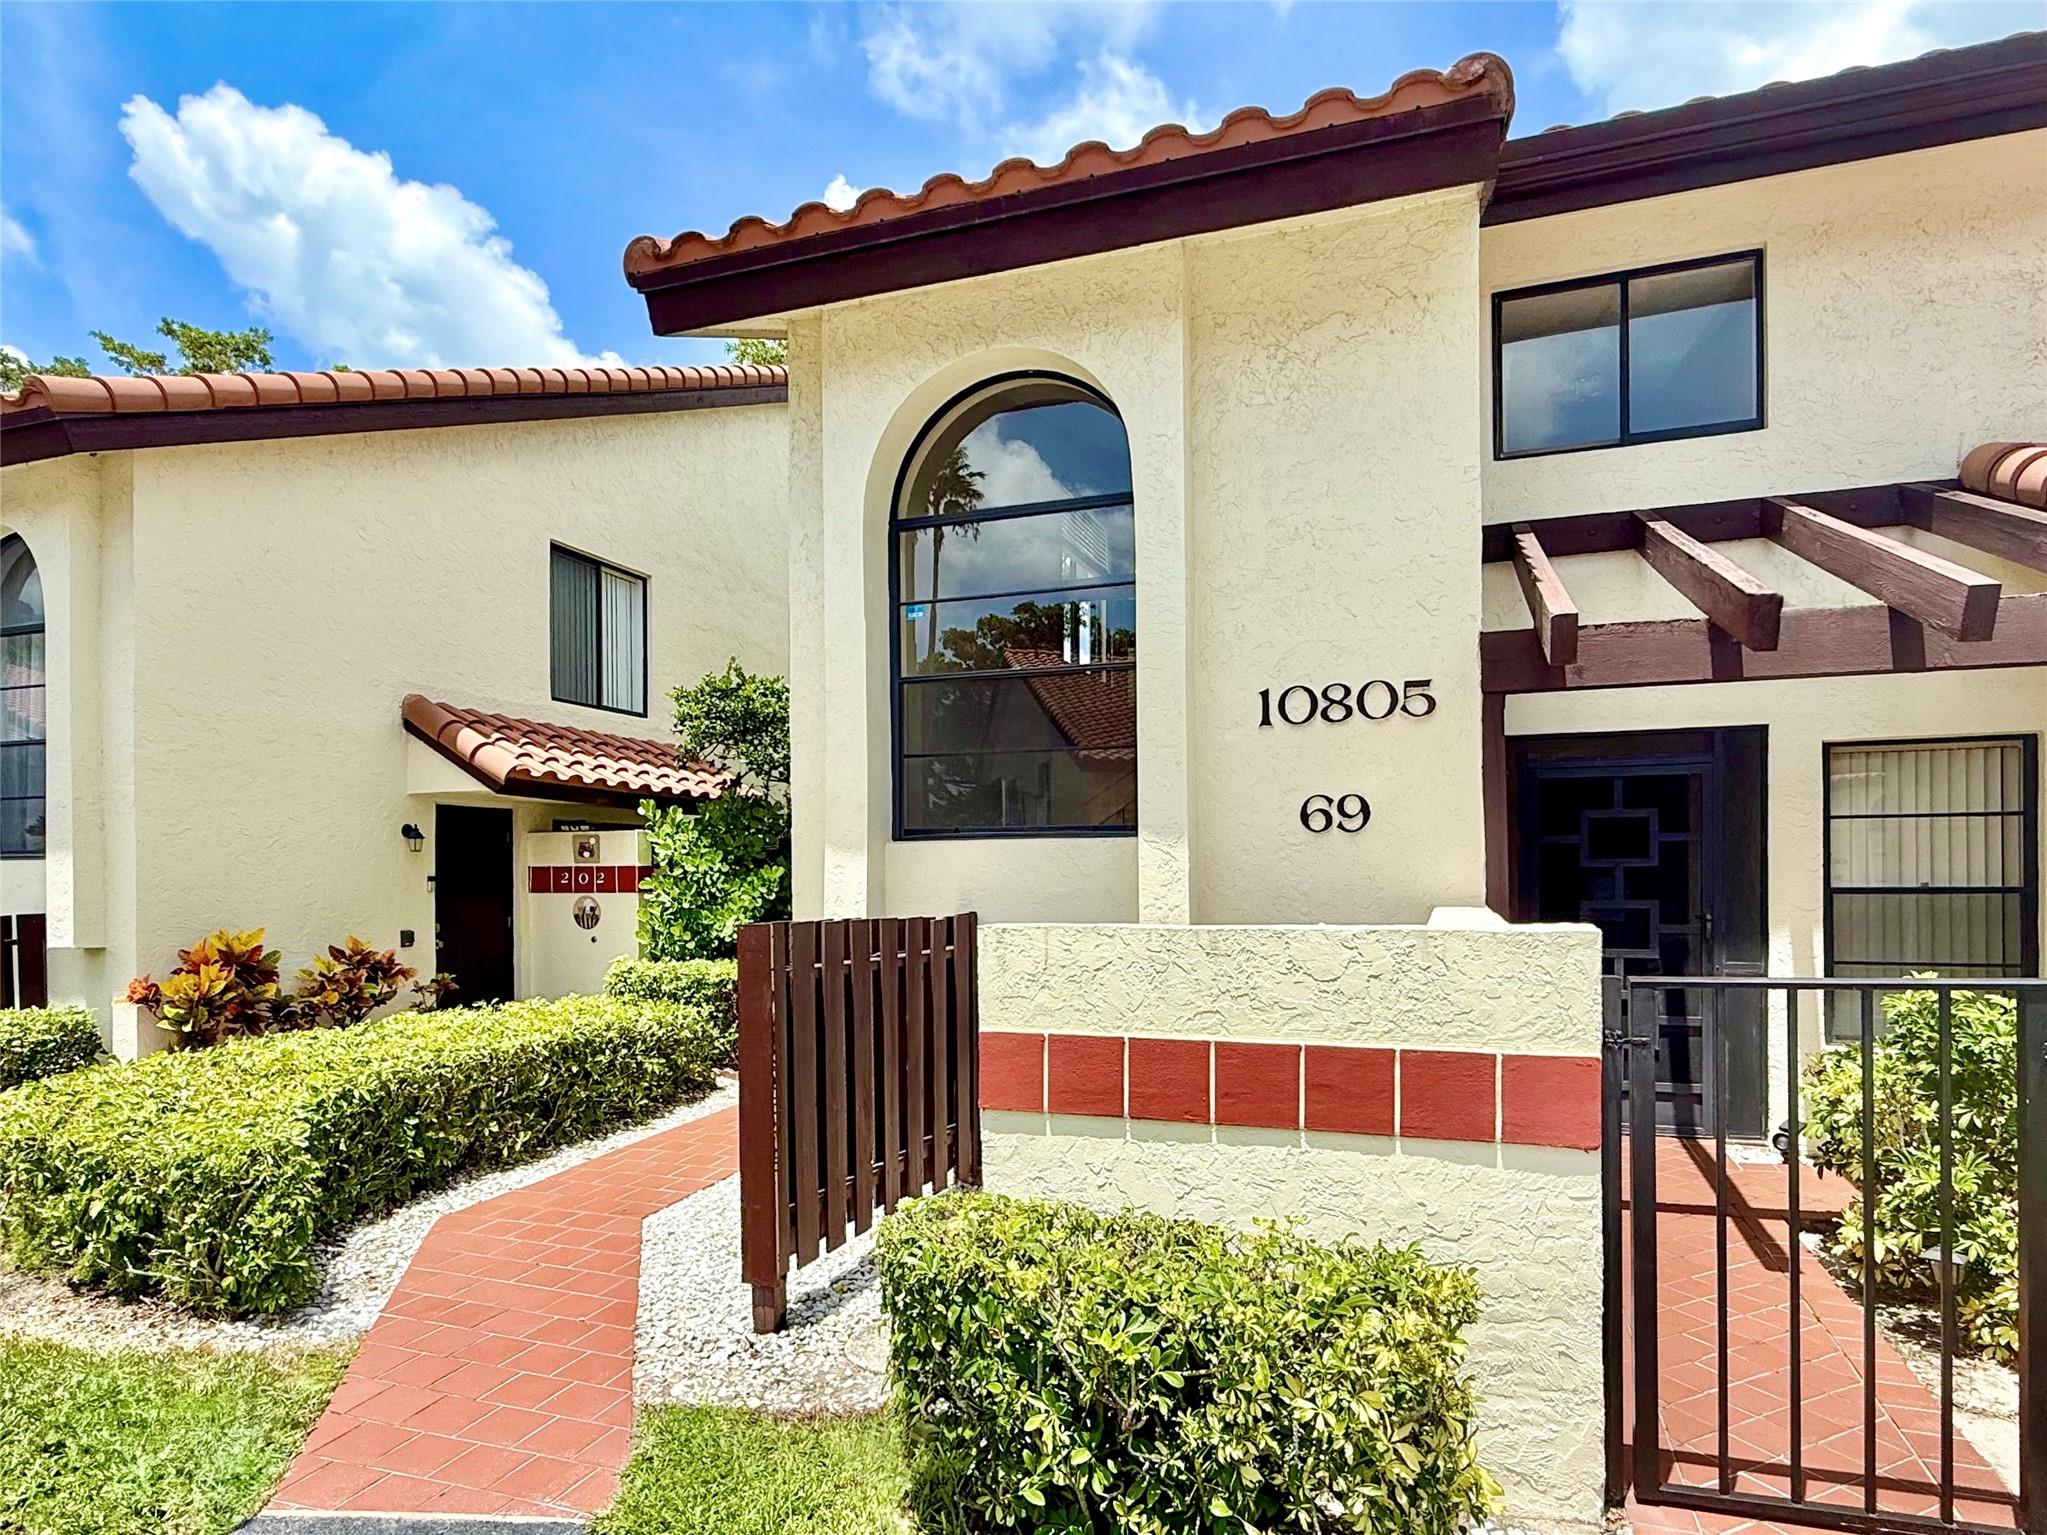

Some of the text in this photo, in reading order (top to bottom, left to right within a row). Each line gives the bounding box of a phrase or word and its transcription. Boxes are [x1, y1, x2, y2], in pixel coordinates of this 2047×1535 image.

[1258, 679, 1437, 727] 10805
[1300, 794, 1371, 833] 69
[560, 872, 605, 885] 202
